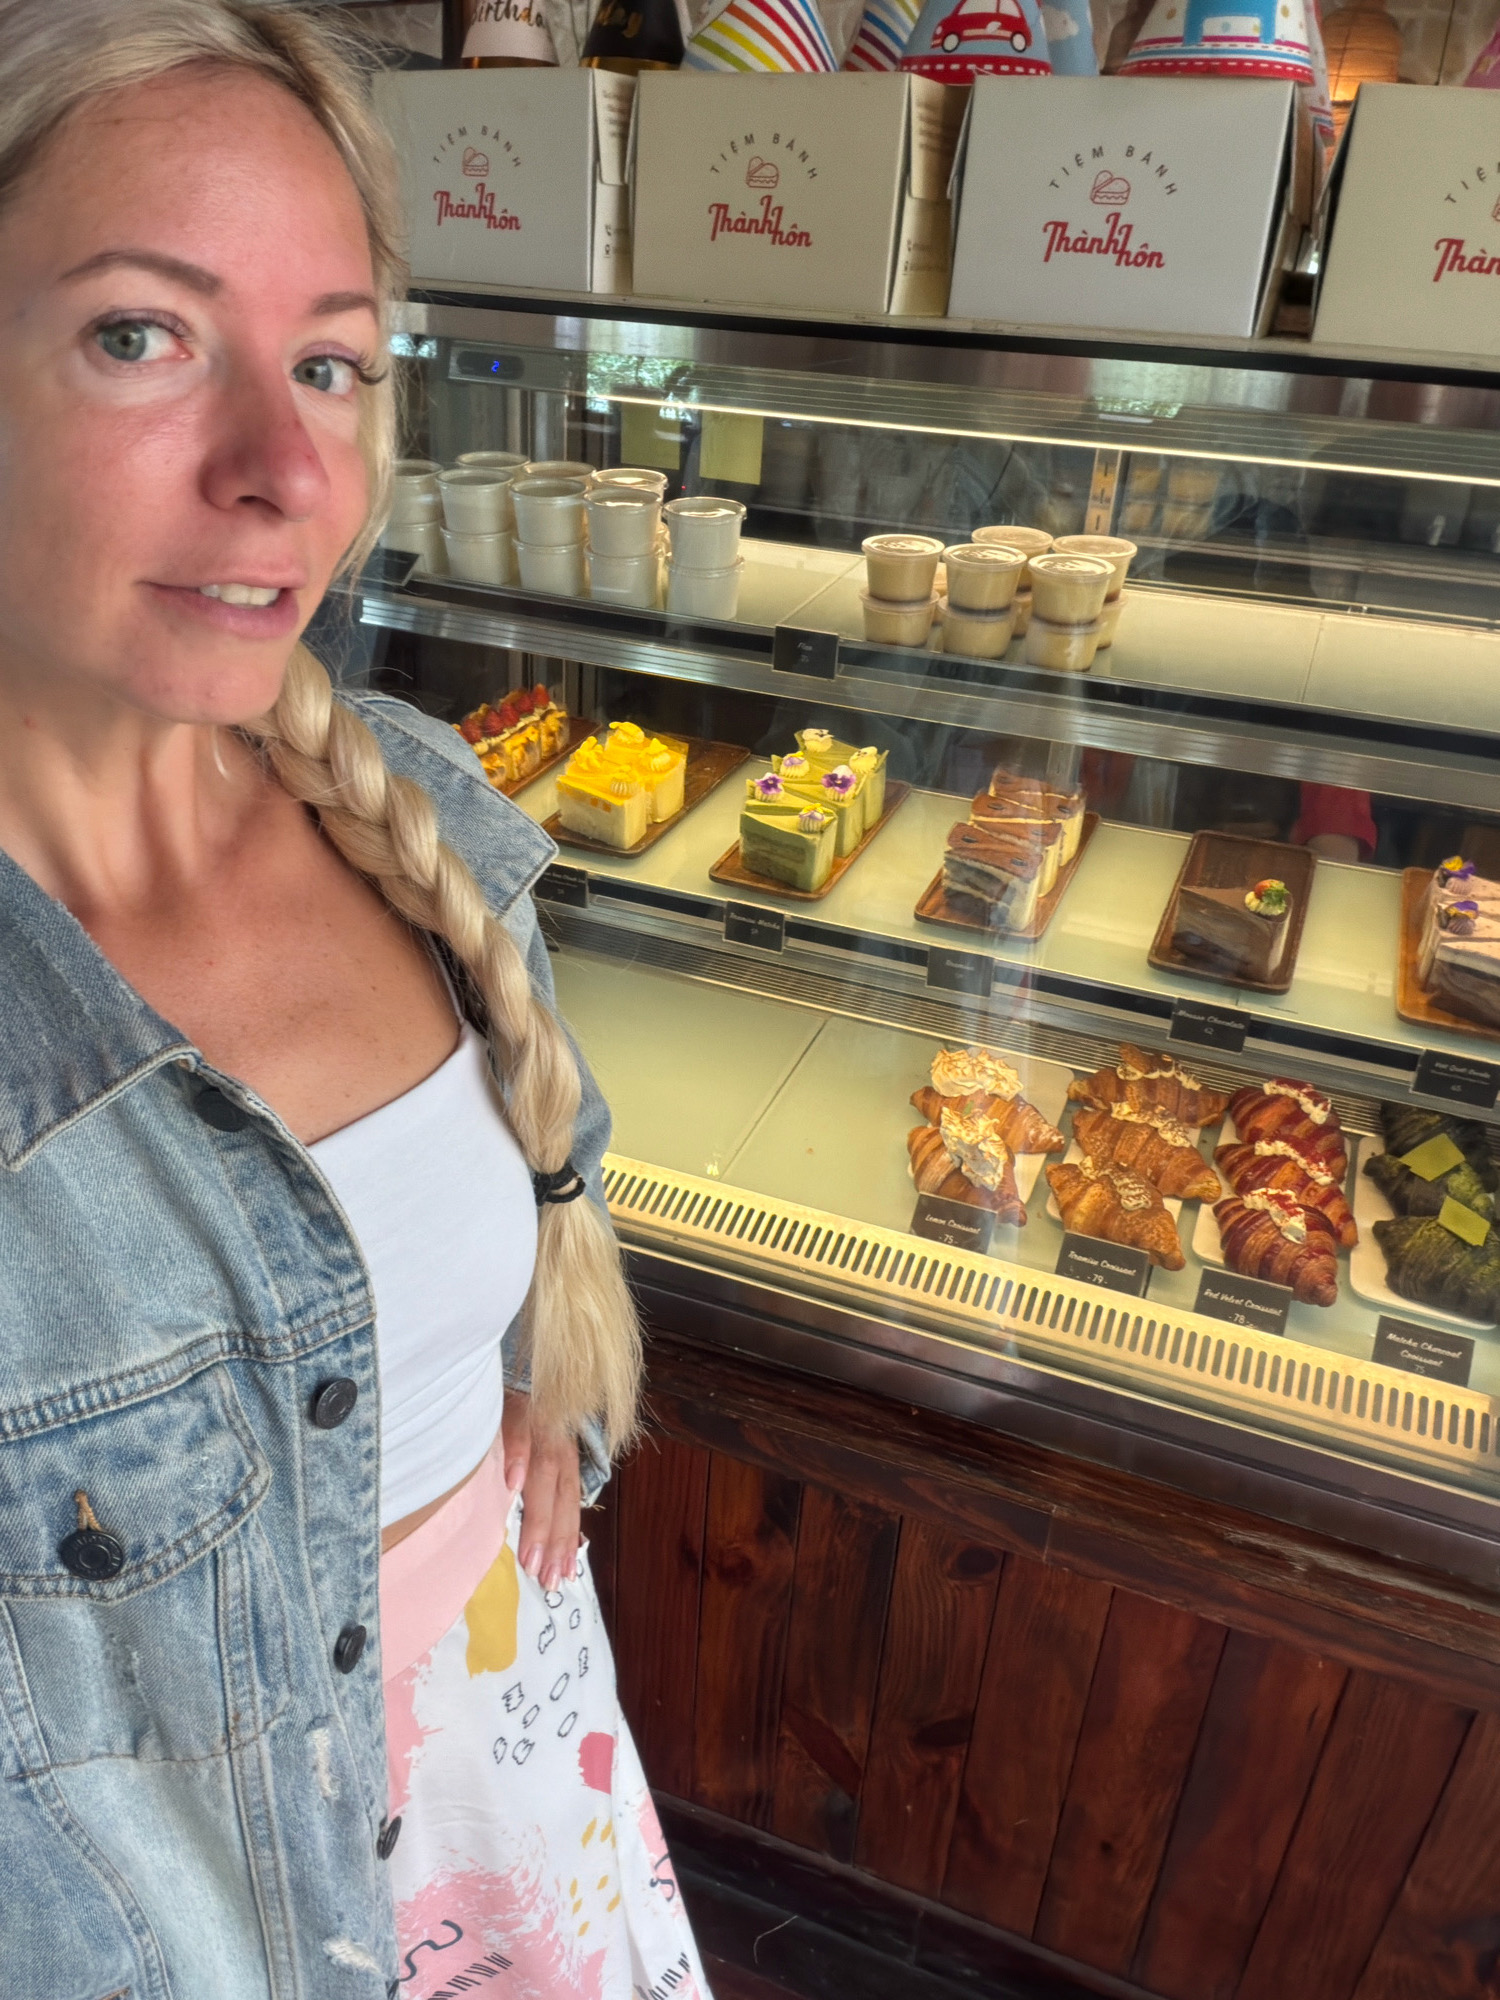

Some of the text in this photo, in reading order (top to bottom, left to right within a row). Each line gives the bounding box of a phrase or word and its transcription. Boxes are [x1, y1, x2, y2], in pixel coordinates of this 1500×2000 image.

[1042, 212, 1121, 262] Thành
[491, 360, 500, 373] 2
[925, 1214, 981, 1234] Lemon Croissant
[1100, 1260, 1137, 1276] Croissant
[1203, 1288, 1283, 1316] Red Velvet Croissant
[1386, 1333, 1419, 1348] Matcha
[1401, 1349, 1443, 1367] Croissant
